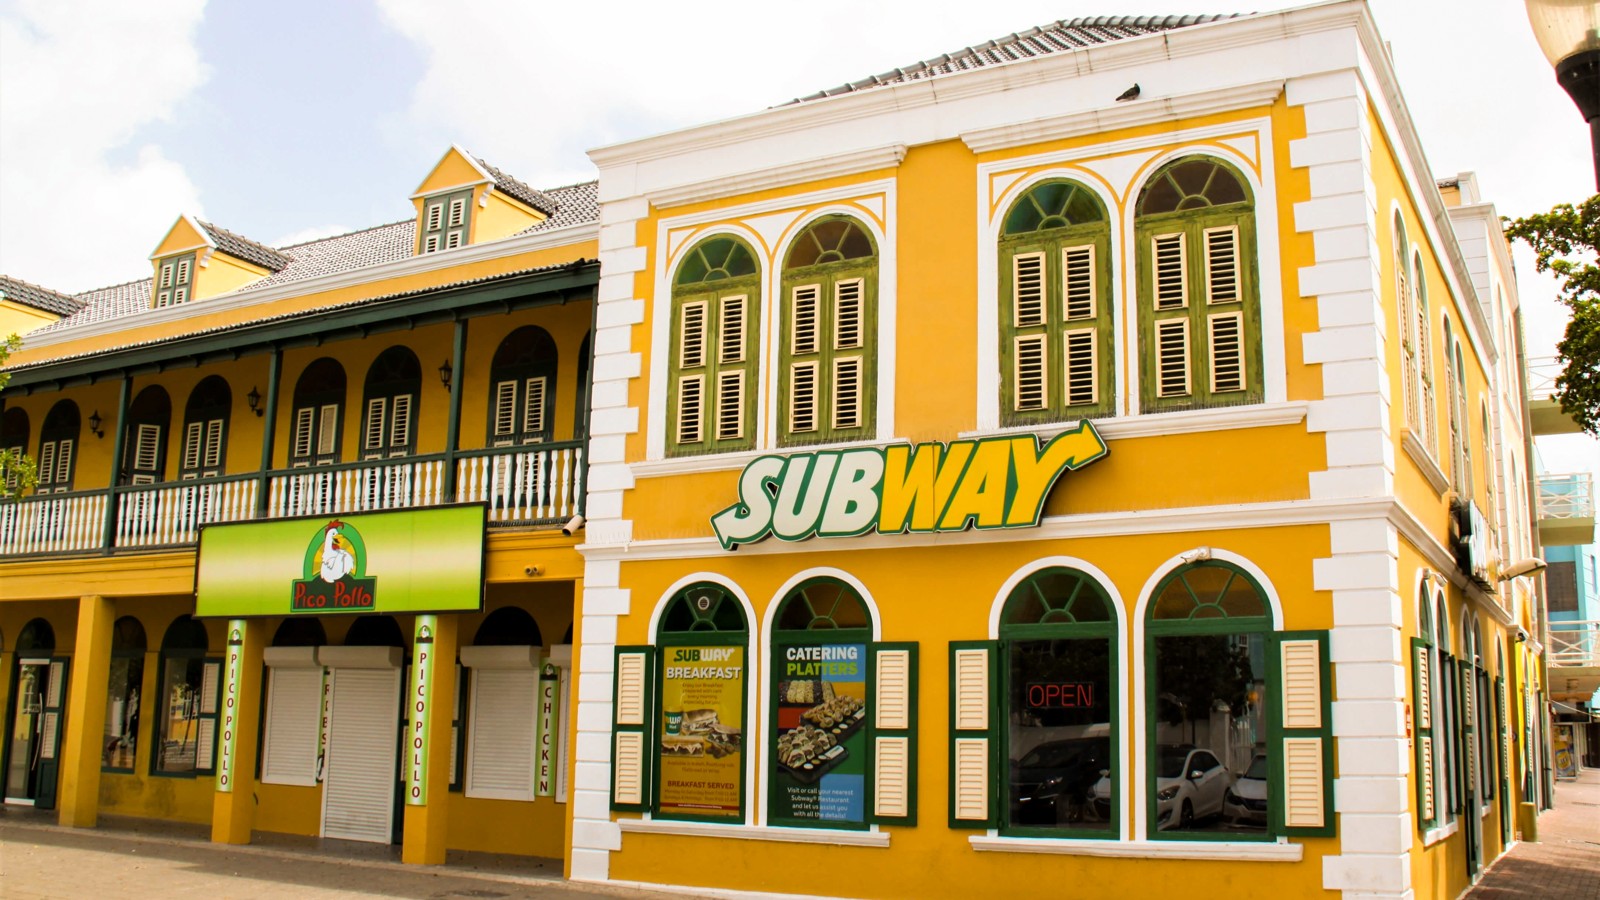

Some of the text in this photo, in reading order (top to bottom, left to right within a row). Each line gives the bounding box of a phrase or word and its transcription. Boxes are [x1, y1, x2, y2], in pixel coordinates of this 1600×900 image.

[712, 418, 1107, 549] SUBWAY
[294, 581, 372, 608] Pico Pollo
[673, 648, 735, 662] SUBWAY
[786, 646, 858, 661] CATERING
[226, 653, 237, 708] PICO
[666, 667, 742, 680] BREAKFAST
[786, 662, 858, 676] PLATTERS
[415, 652, 427, 712] PICO
[1029, 684, 1092, 707] OPEN
[220, 716, 233, 785] POLLO
[540, 687, 552, 792] CHICKEN
[411, 721, 423, 798] POLLO
[667, 780, 735, 790] BREAKFAST SERVED
[818, 795, 849, 803] Restaurant
